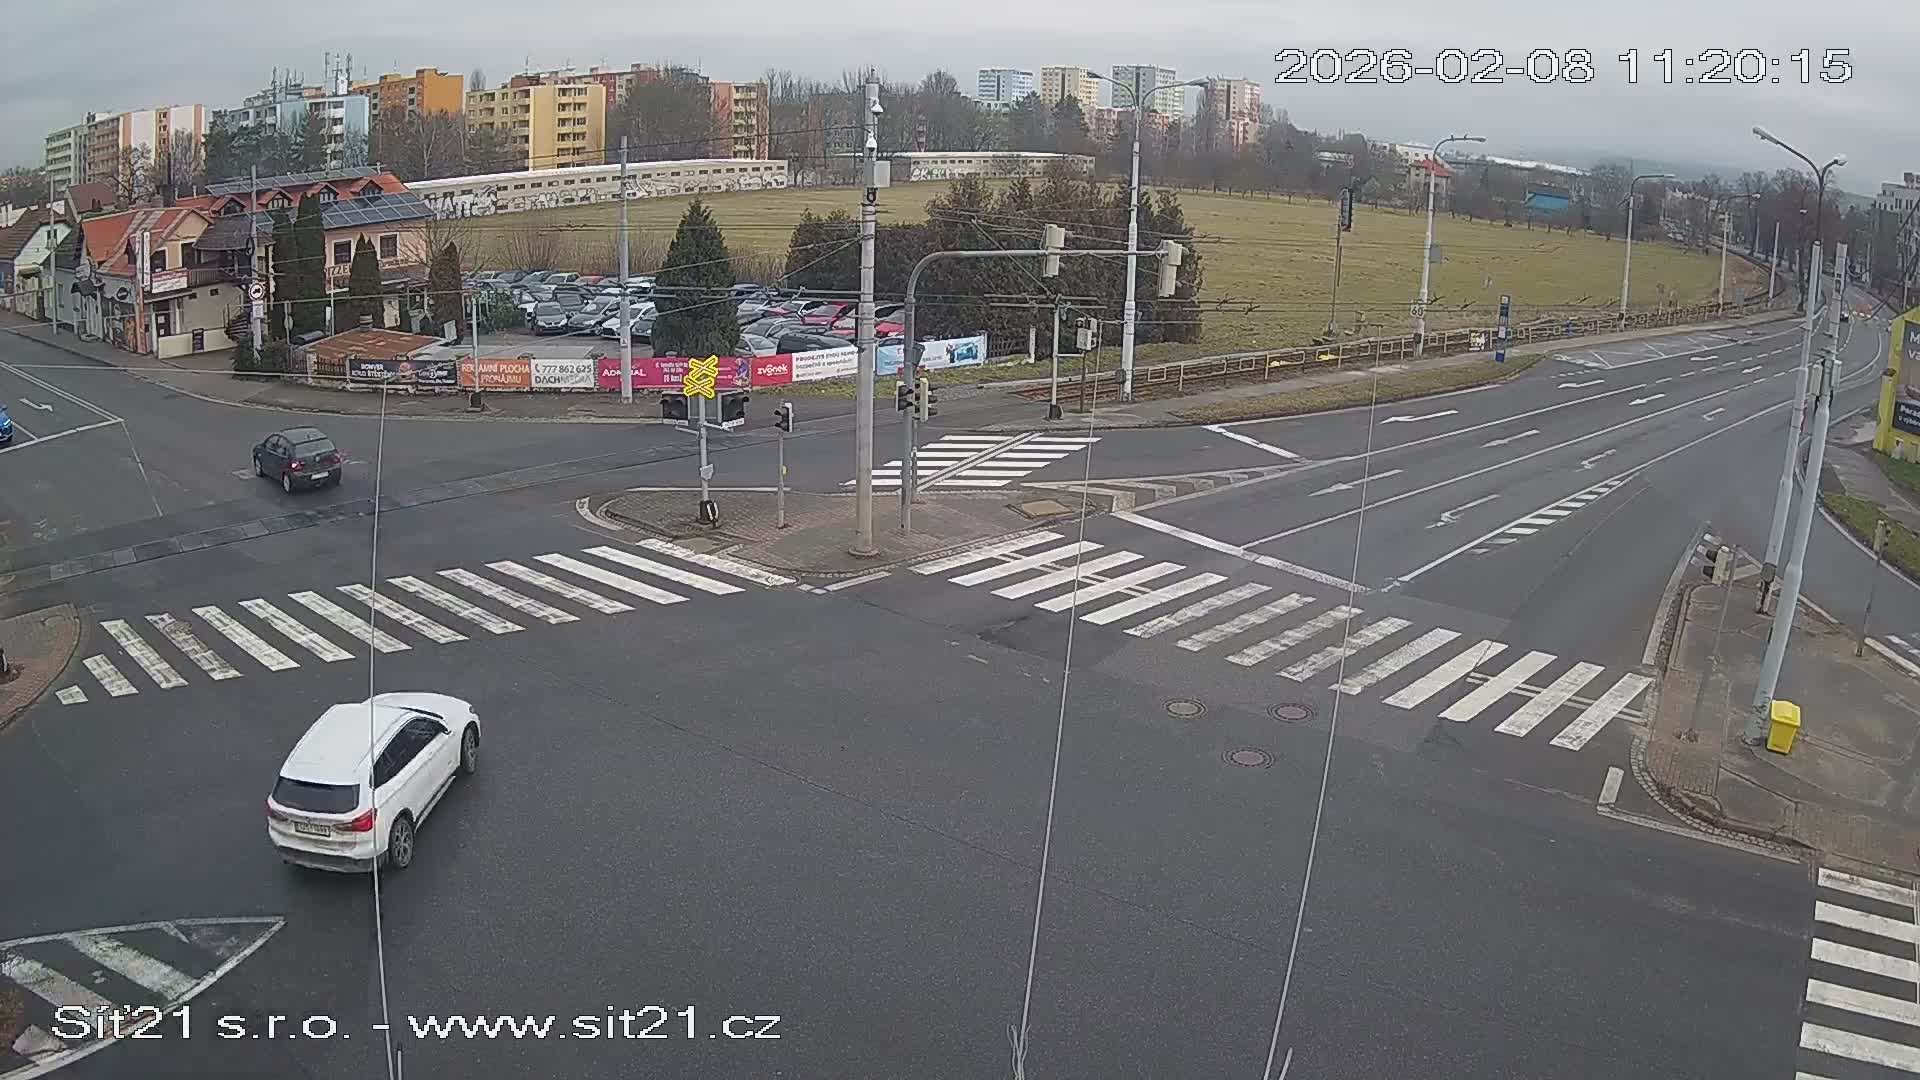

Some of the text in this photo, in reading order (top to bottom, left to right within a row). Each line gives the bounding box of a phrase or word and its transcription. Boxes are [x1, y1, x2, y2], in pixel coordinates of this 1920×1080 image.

[1411, 305, 1424, 317] 60
[461, 363, 498, 373] REKAMNÍ
[499, 364, 530, 374] PLOCHA
[542, 364, 592, 374] 777 862 625
[602, 368, 646, 377] ADMAL
